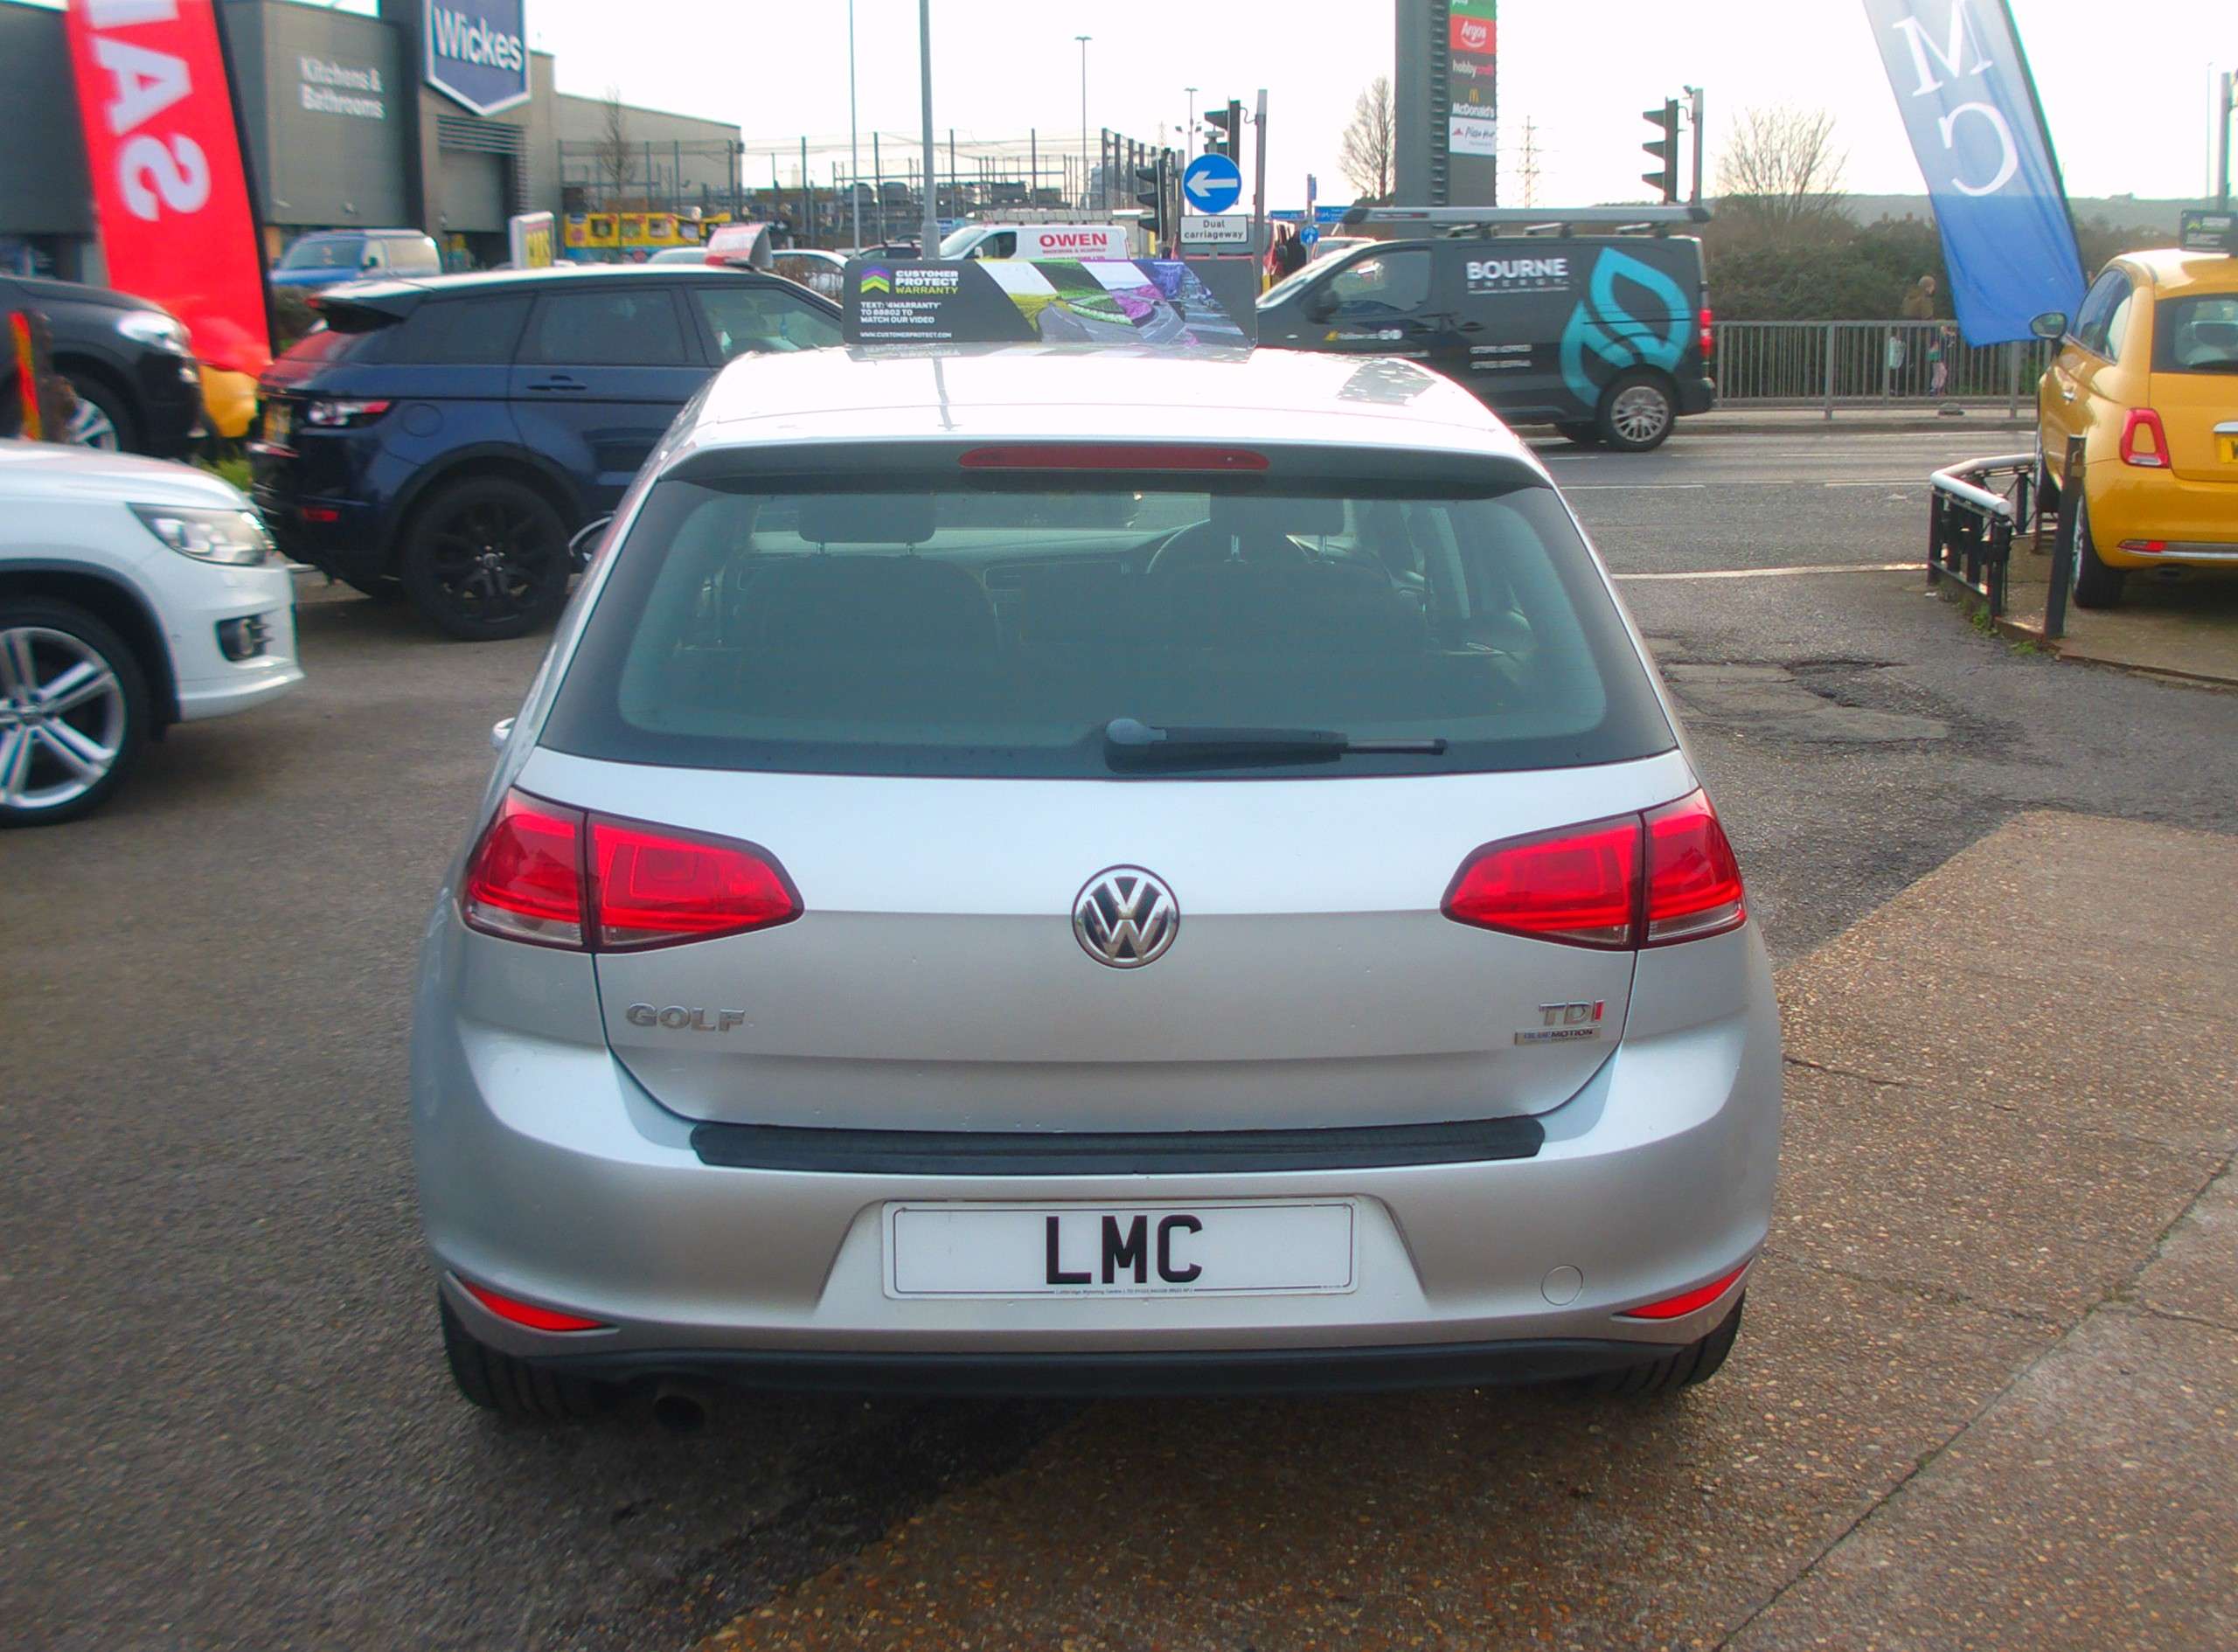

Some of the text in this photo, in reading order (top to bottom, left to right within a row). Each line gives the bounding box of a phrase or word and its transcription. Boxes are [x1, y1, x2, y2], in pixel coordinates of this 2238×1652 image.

[434, 7, 522, 71] Wickes
[1461, 21, 1486, 41] Argos
[1452, 59, 1493, 78] hobby
[301, 83, 385, 118] Bathrooms
[1452, 102, 1494, 118] McDonald's
[1203, 219, 1225, 228] Dual
[1039, 233, 1107, 247] OWEN
[1184, 231, 1243, 239] carriageway
[1466, 258, 1568, 280] BOURNE
[626, 1003, 746, 1031] GOLF
[1539, 1000, 1605, 1026] TDI
[1046, 1214, 1203, 1284] LMC
